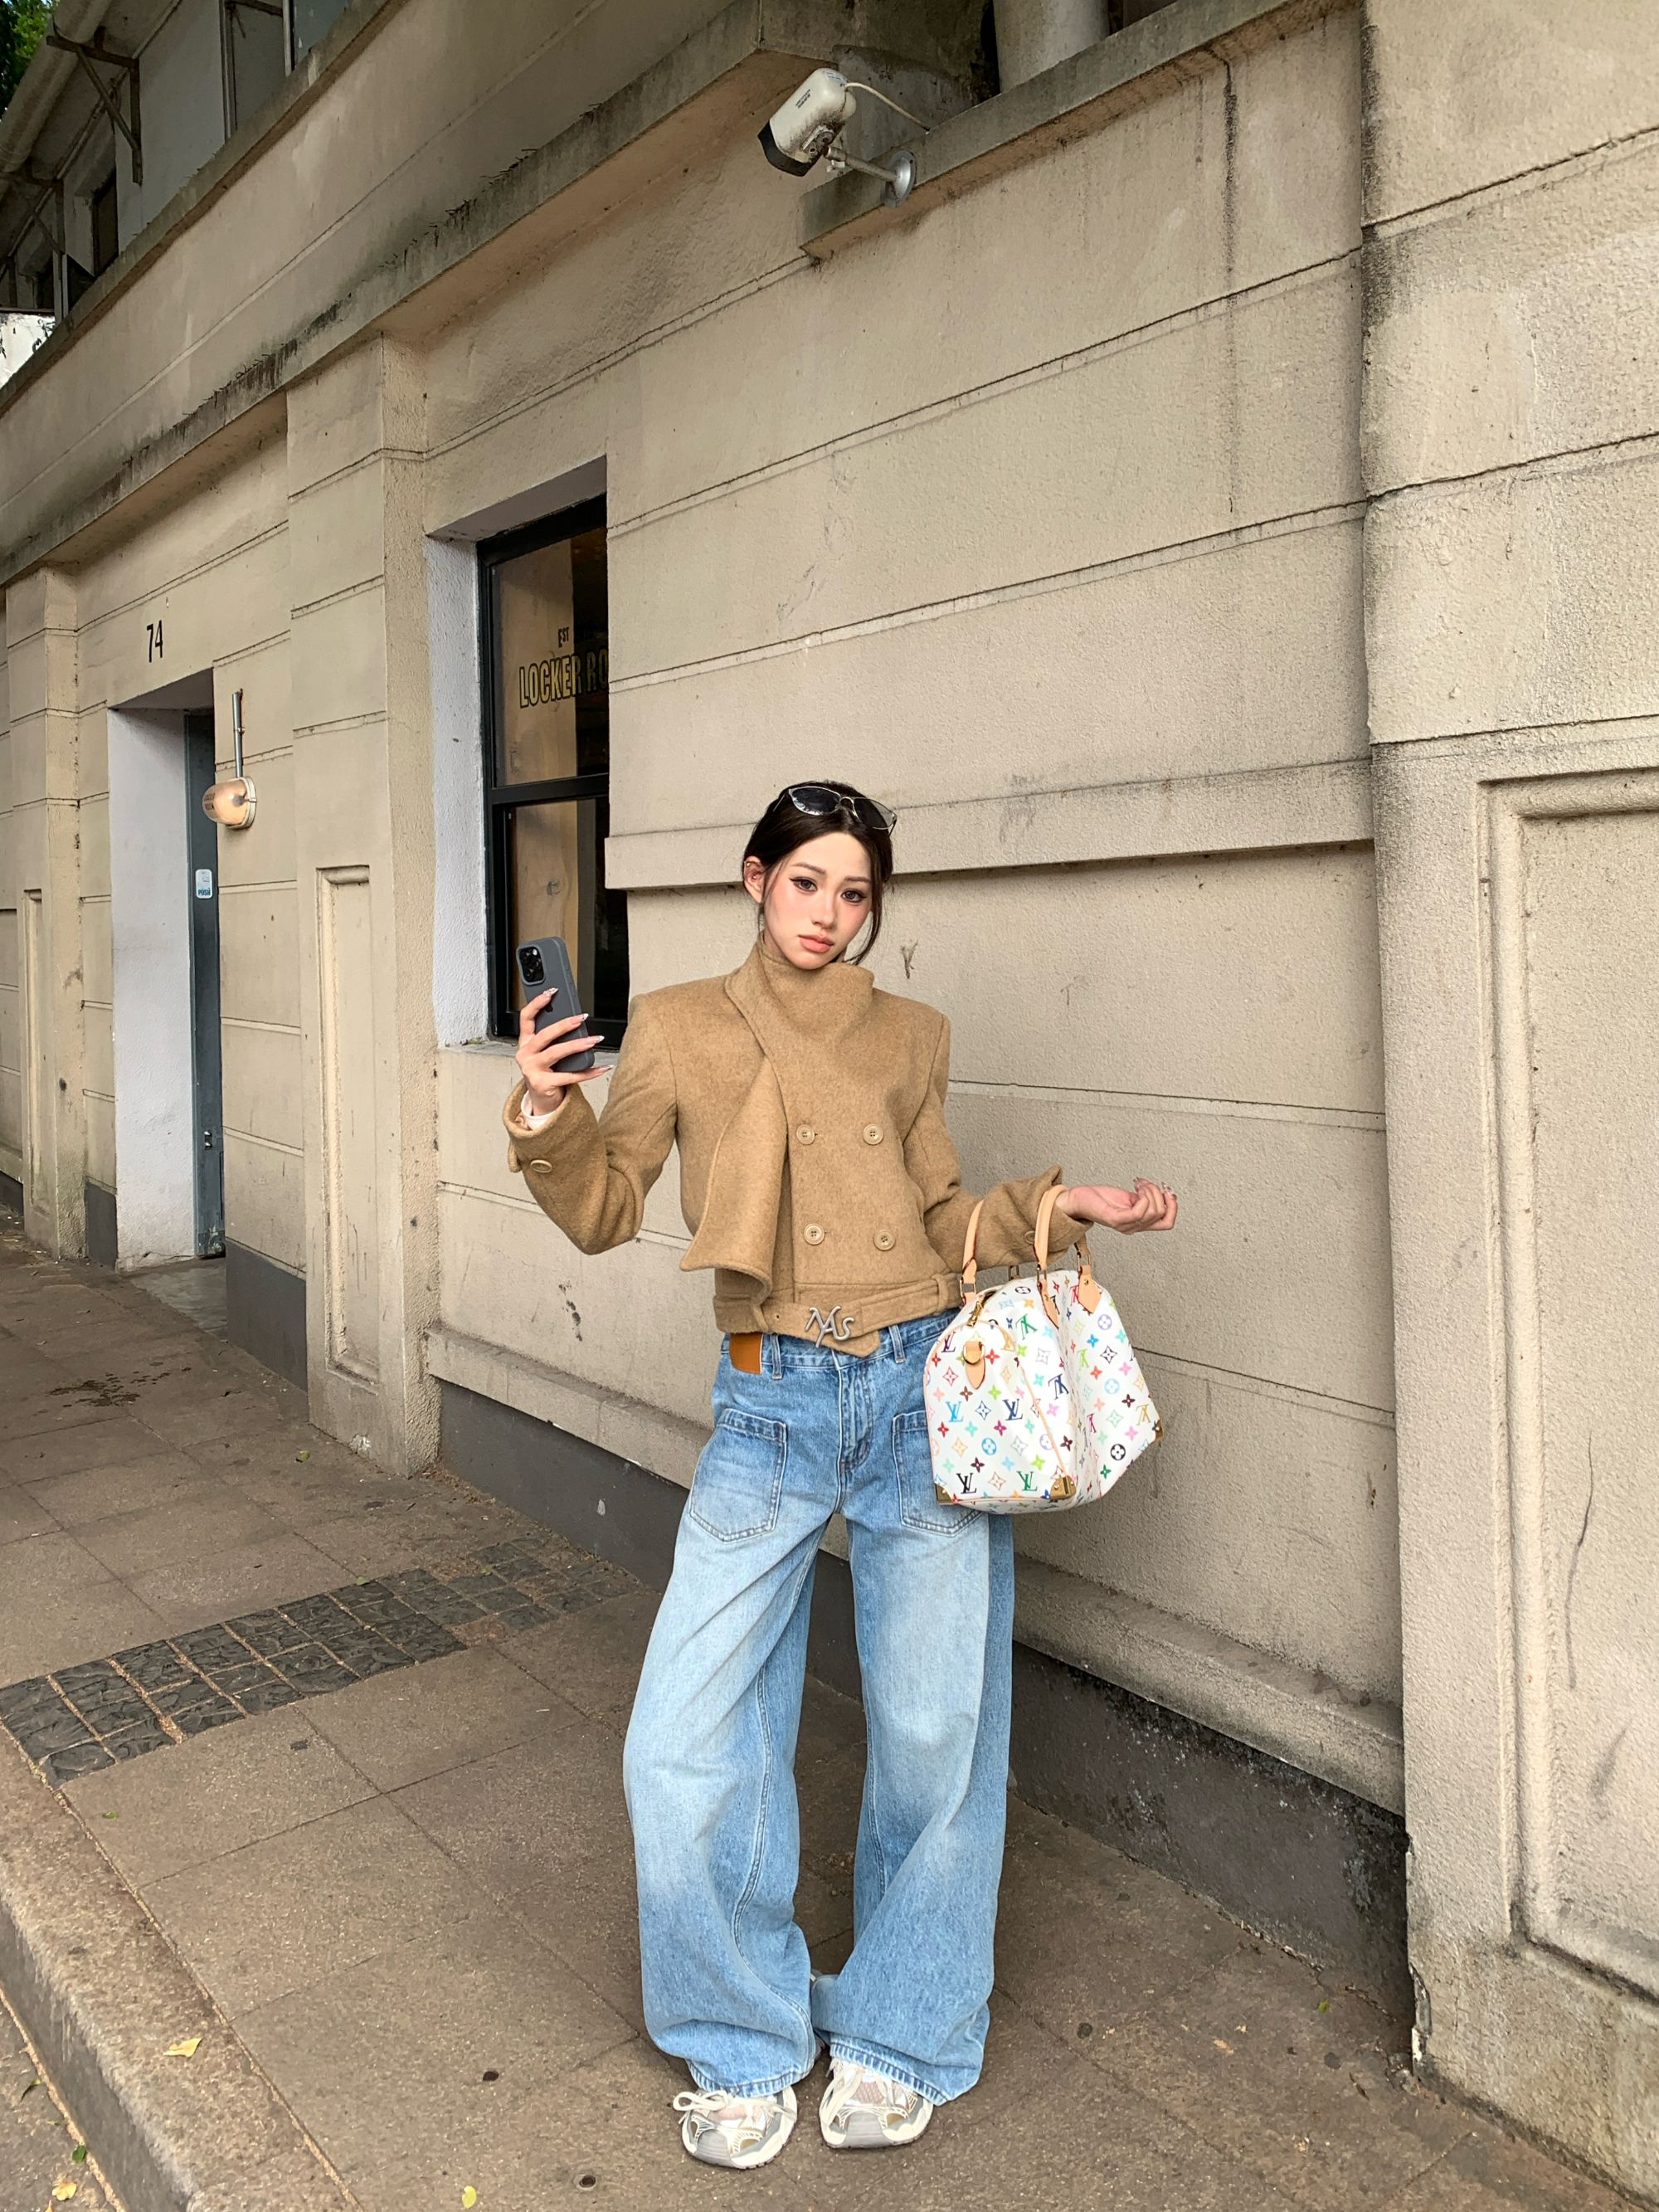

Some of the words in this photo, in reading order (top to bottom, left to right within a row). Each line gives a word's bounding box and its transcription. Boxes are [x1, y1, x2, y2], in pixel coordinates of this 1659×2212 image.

[147, 620, 163, 663] 74
[558, 626, 570, 648] EST
[519, 653, 581, 709] LOCKER
